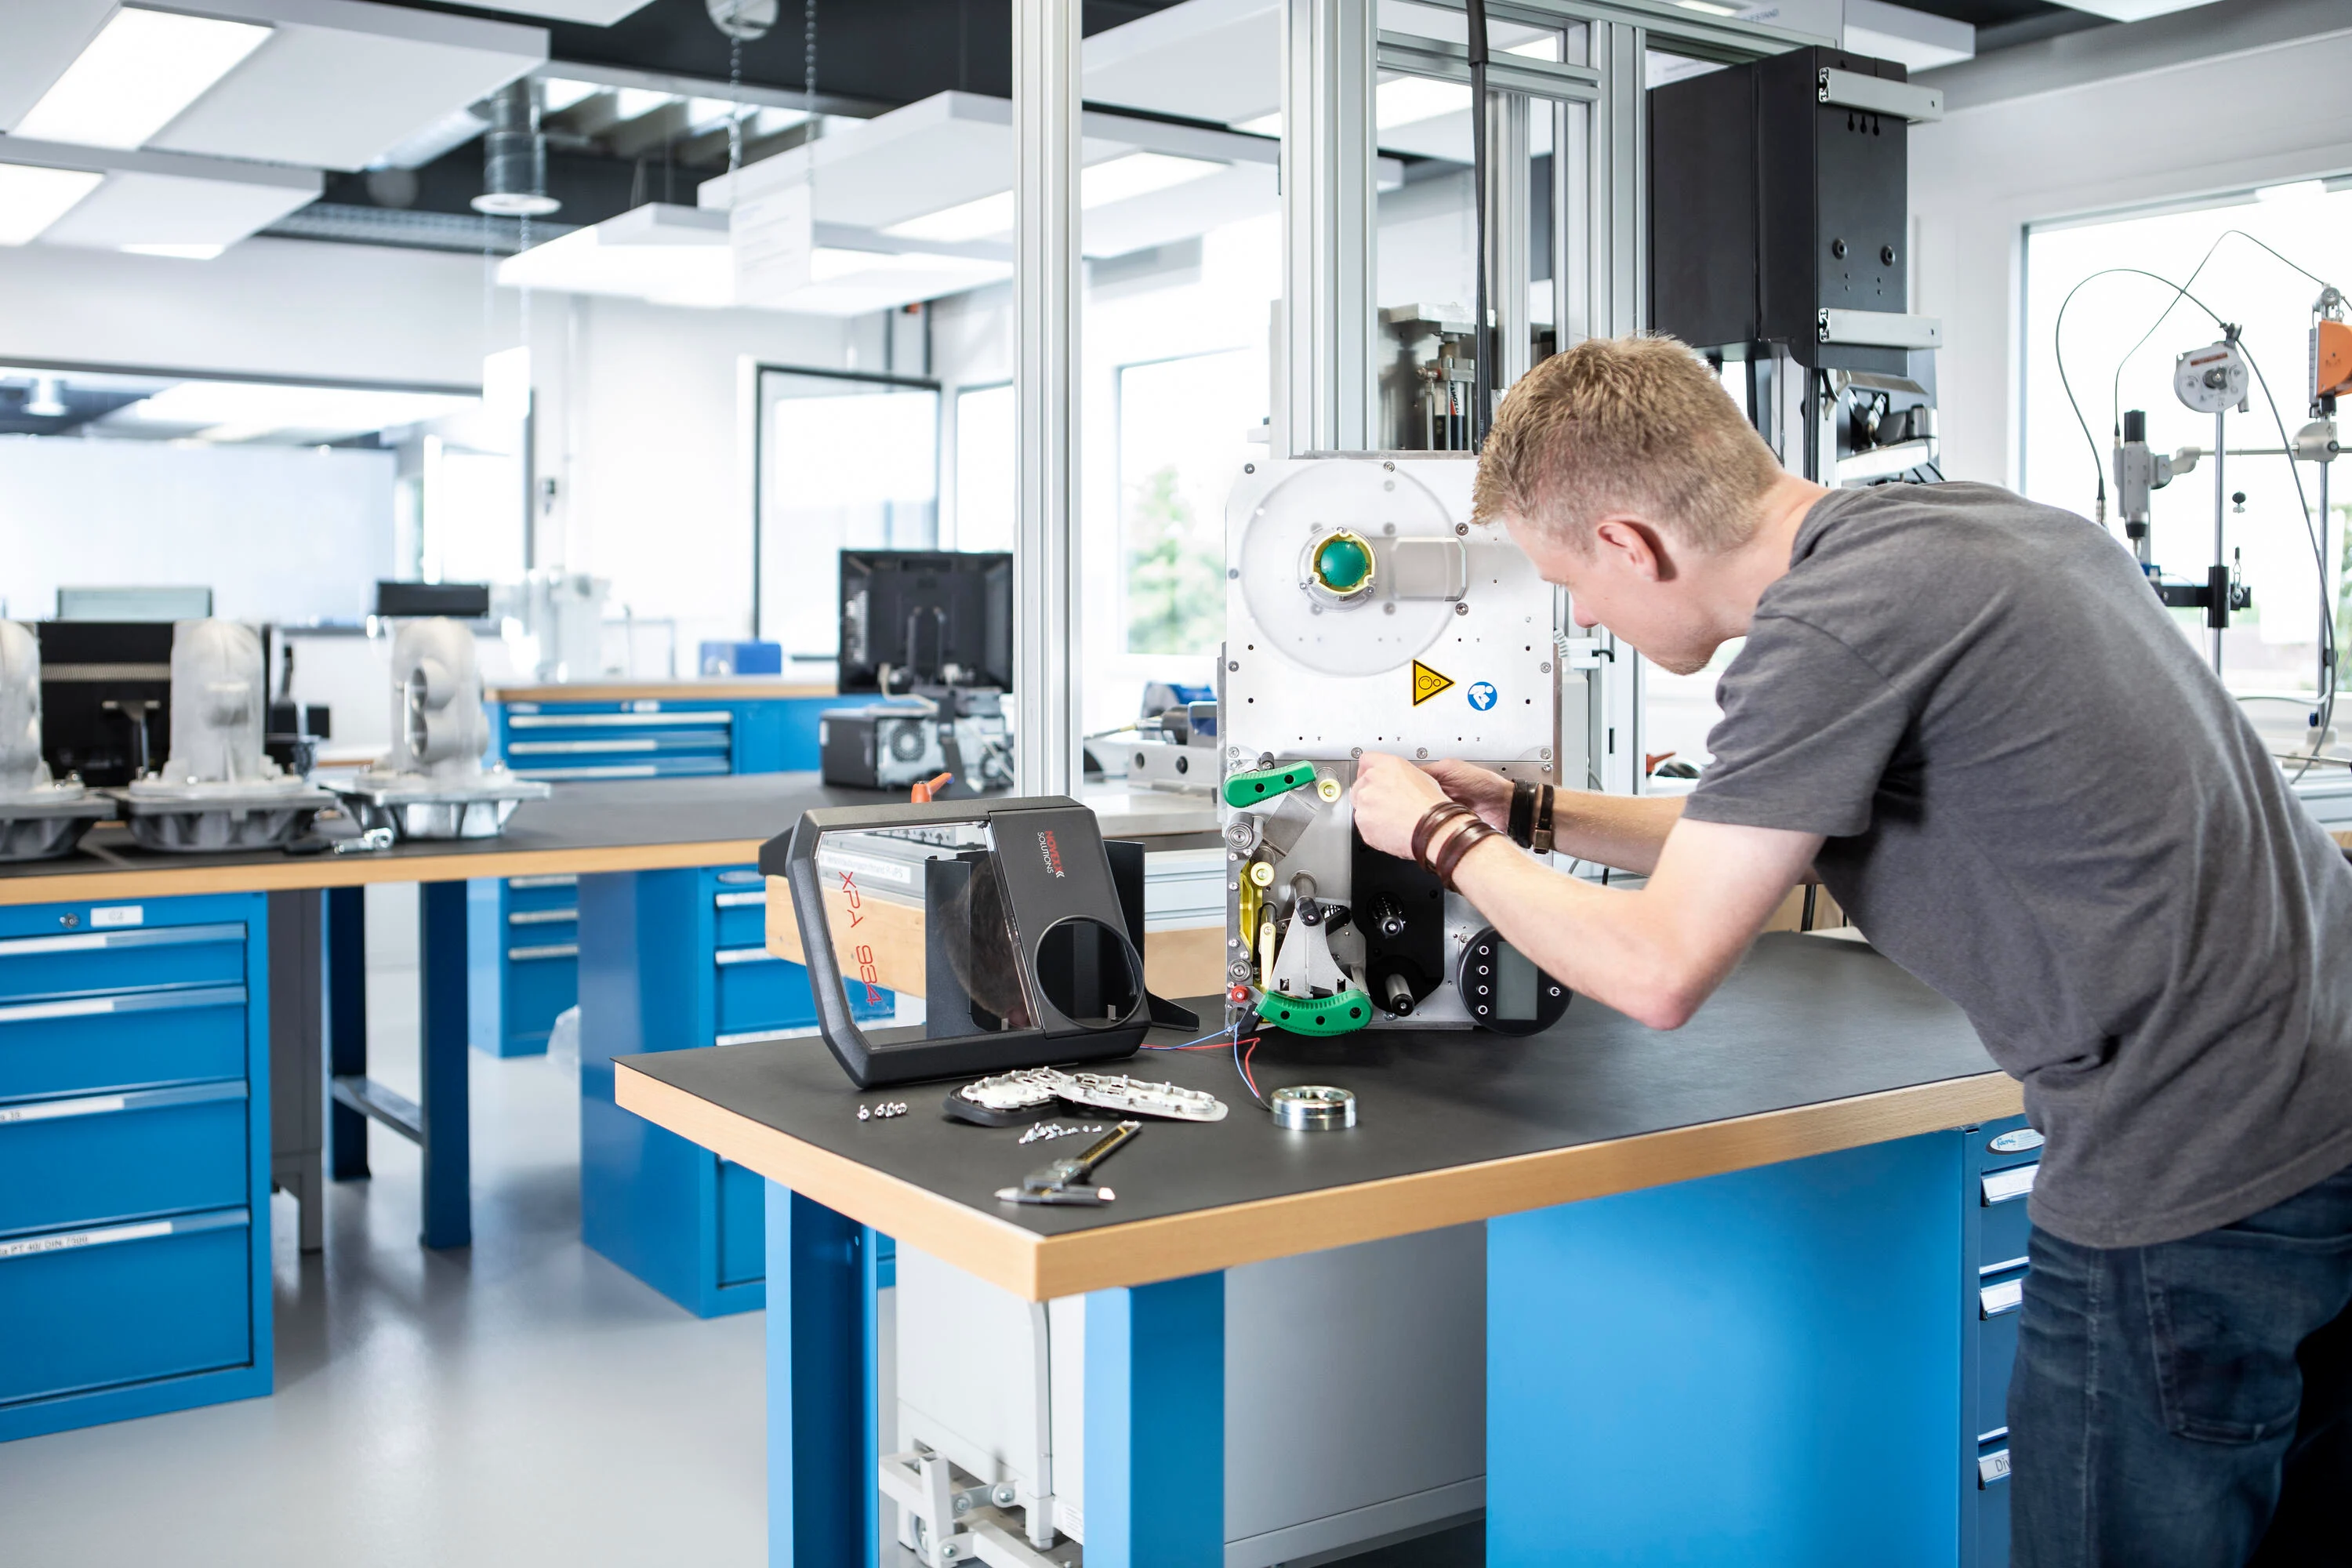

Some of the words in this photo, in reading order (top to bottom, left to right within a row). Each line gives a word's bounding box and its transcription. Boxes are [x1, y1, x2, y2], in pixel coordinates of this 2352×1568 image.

[1037, 832, 1054, 873] SOLUTIONS
[839, 871, 863, 928] XPA
[856, 945, 882, 1005] 934
